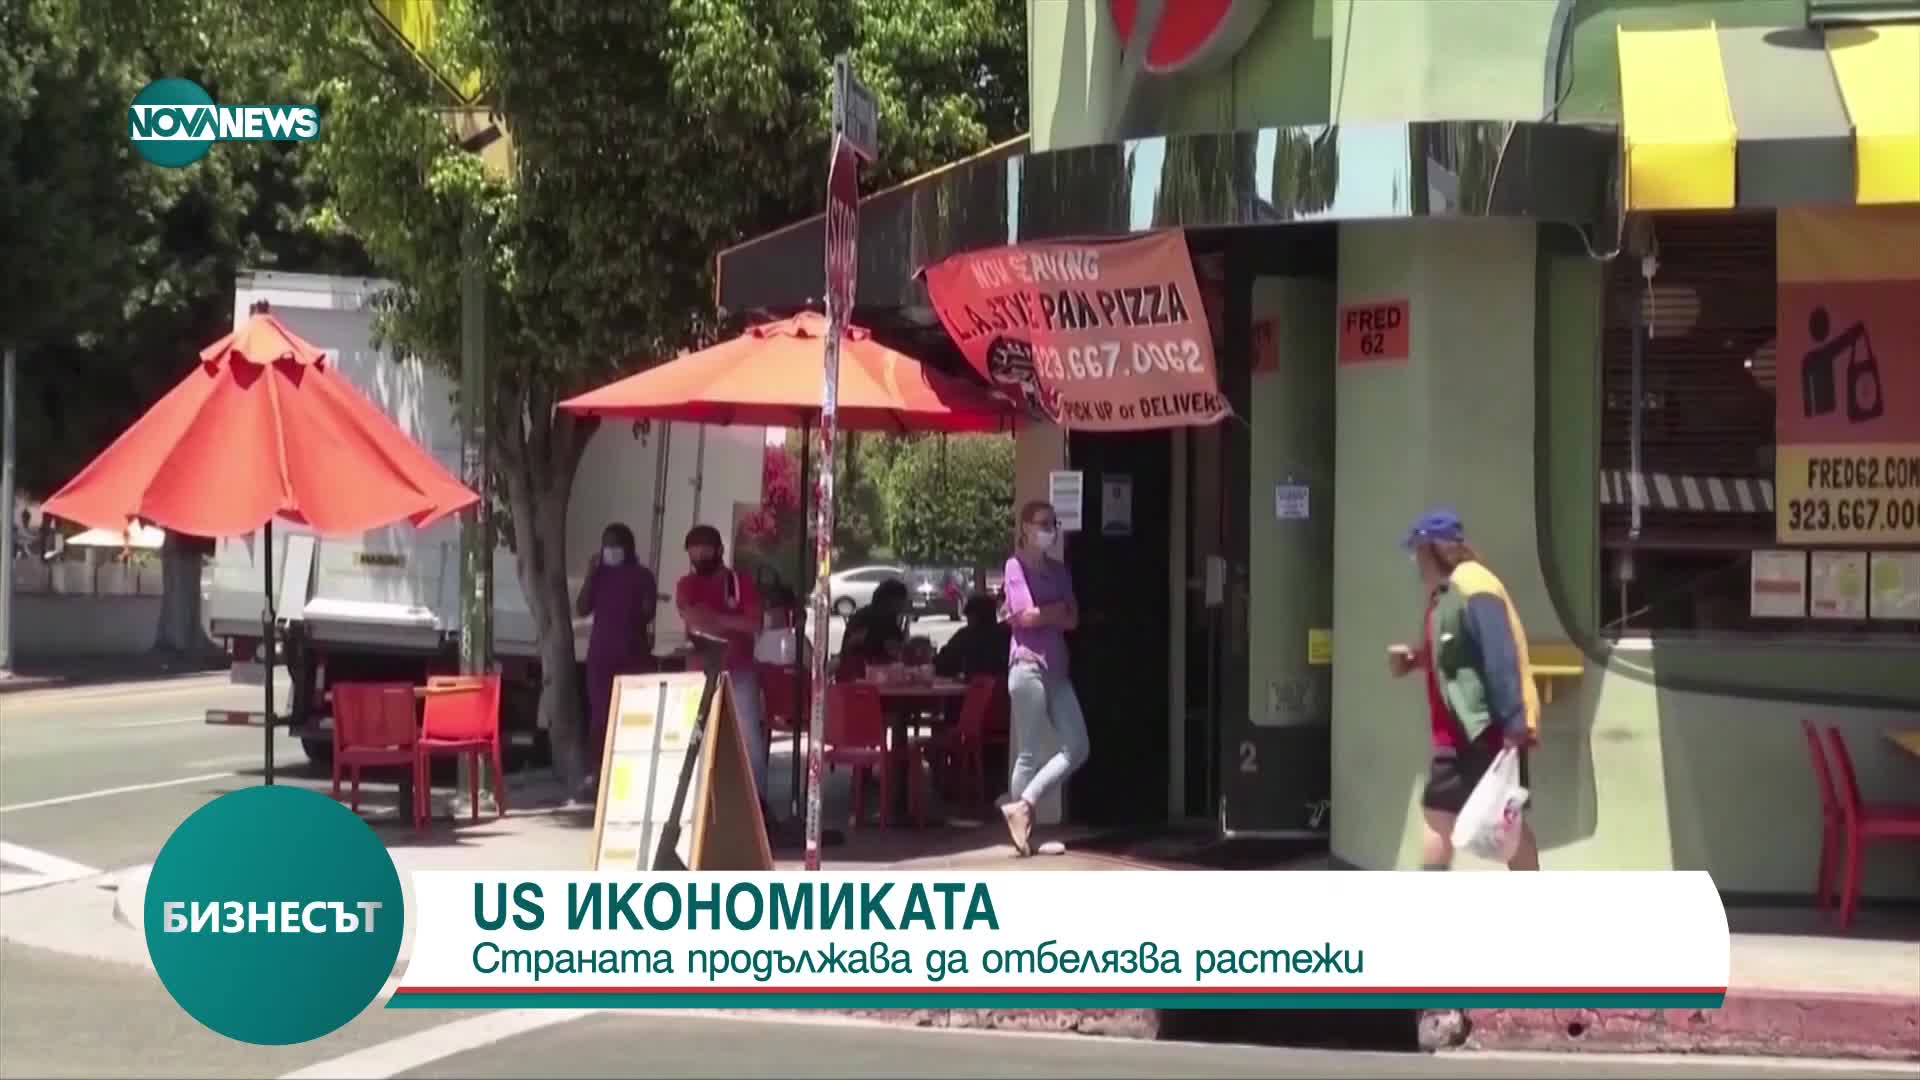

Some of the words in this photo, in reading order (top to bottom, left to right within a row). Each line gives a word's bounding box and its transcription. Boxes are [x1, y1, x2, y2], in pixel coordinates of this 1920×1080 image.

[829, 197, 857, 265] STOP
[1039, 287, 1099, 331] PAN
[1096, 282, 1190, 327] PIZZA
[1346, 306, 1401, 335] FRED
[1361, 334, 1385, 356] 62
[1095, 399, 1113, 421] UP
[1119, 402, 1136, 421] or
[1788, 498, 1920, 532] 323.667.00
[1240, 741, 1258, 773] 2
